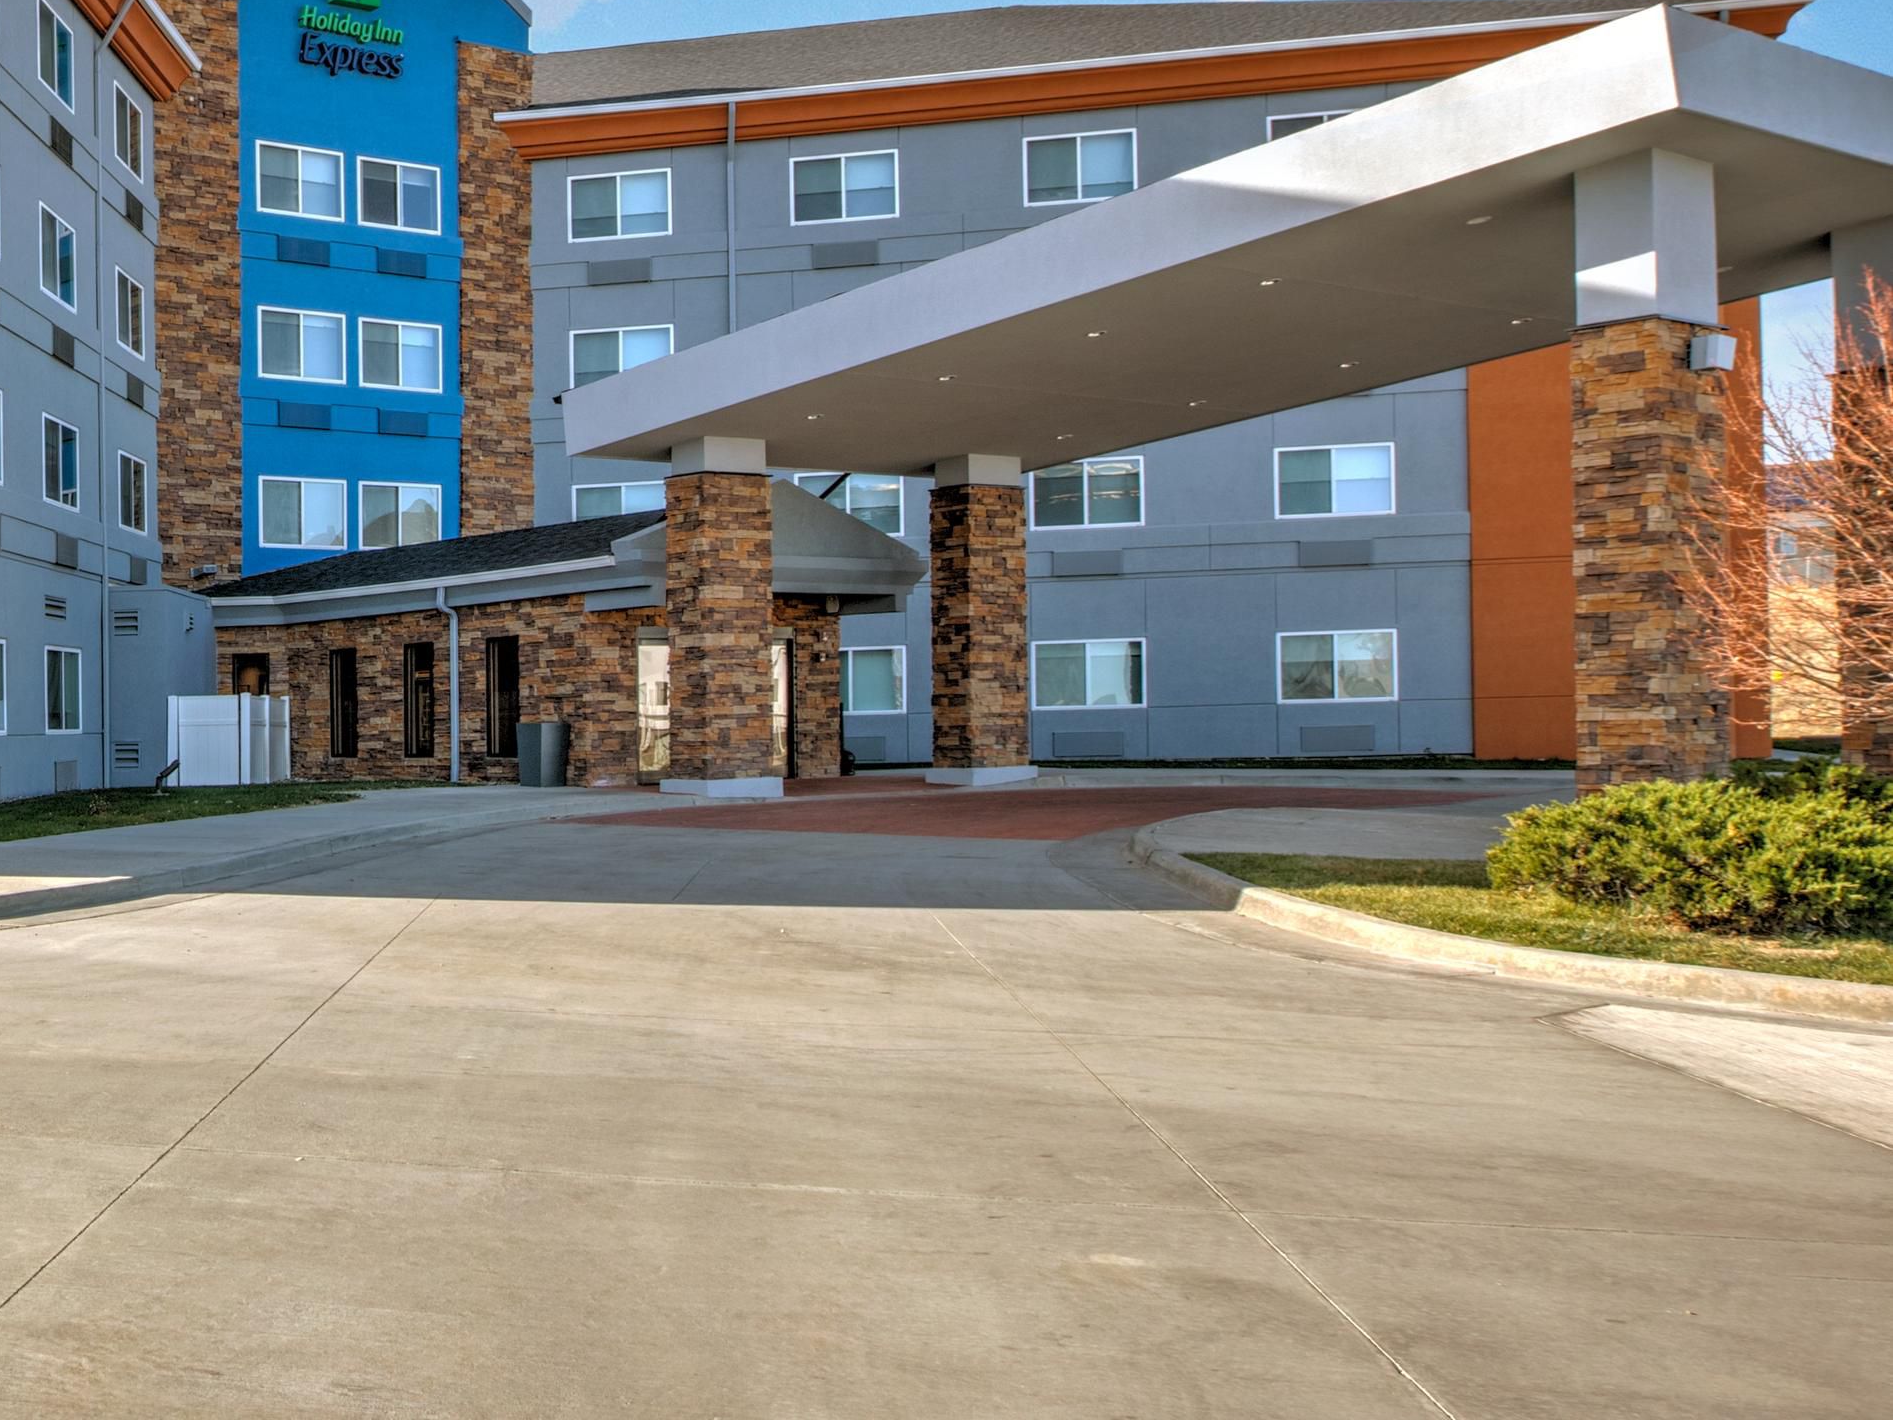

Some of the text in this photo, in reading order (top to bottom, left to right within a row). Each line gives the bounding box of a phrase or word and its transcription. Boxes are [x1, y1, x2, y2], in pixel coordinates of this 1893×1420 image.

[299, 5, 403, 45] Holiday Inn
[299, 32, 404, 78] Express
